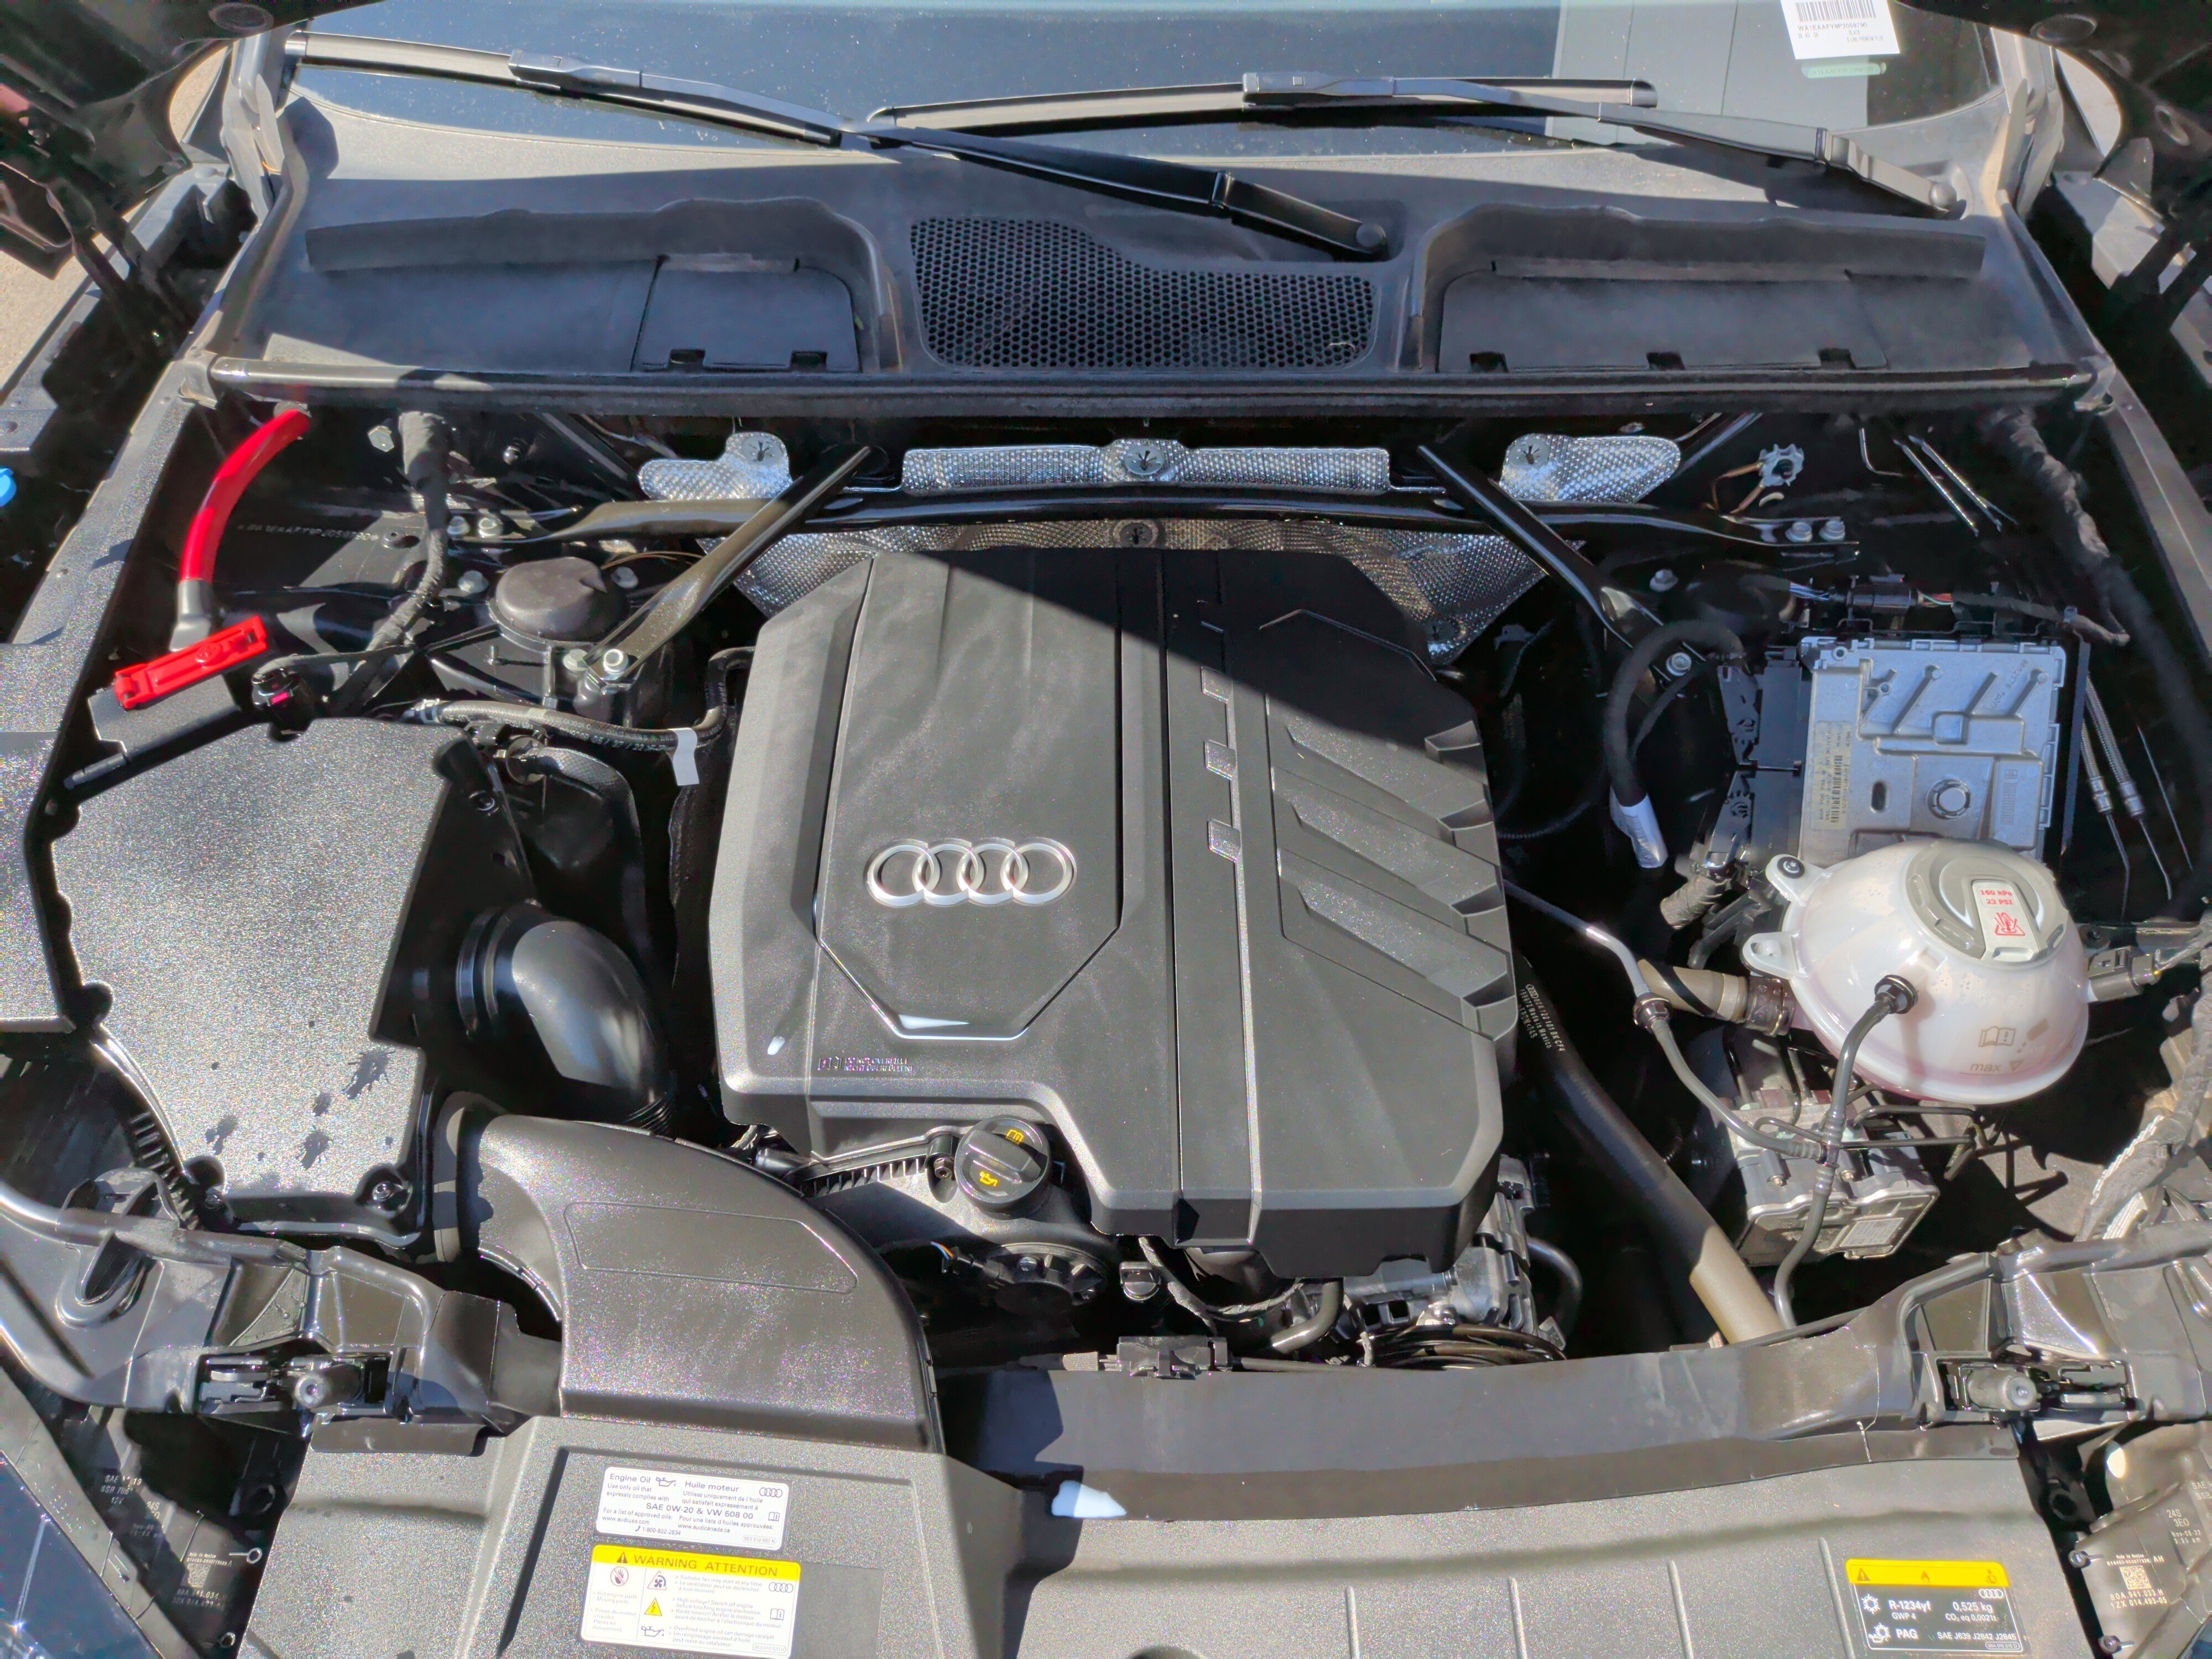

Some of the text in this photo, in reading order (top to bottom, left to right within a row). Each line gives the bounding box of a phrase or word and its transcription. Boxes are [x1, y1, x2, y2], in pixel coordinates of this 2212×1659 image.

[1538, 1028, 1552, 1049] Mexico
[1969, 1062, 2001, 1072] max
[609, 1473, 638, 1483] Engine
[684, 1480, 739, 1492] Huile moteur
[2192, 1481, 2208, 1490] SAE
[606, 1490, 632, 1499] expressly
[703, 1492, 737, 1501] uniquement
[634, 1510, 660, 1519] approved
[665, 1504, 693, 1514] 0W-20
[706, 1508, 722, 1516] VW
[724, 1510, 740, 1518] 508
[2167, 1509, 2182, 1518] 24S
[602, 1515, 650, 1525] www.audiusa.com
[641, 1526, 681, 1536] 1-800-822-2834
[677, 1522, 731, 1533] www.audicanada.ca
[633, 1554, 778, 1576] WARNING ATTENTION
[1887, 1599, 1932, 1613] R-1234yf
[1980, 1601, 1993, 1613] kg
[1891, 1611, 1910, 1620] GWP
[733, 1630, 754, 1639] damage
[1895, 1628, 1919, 1640] PAG
[1937, 1631, 1953, 1640] SAE
